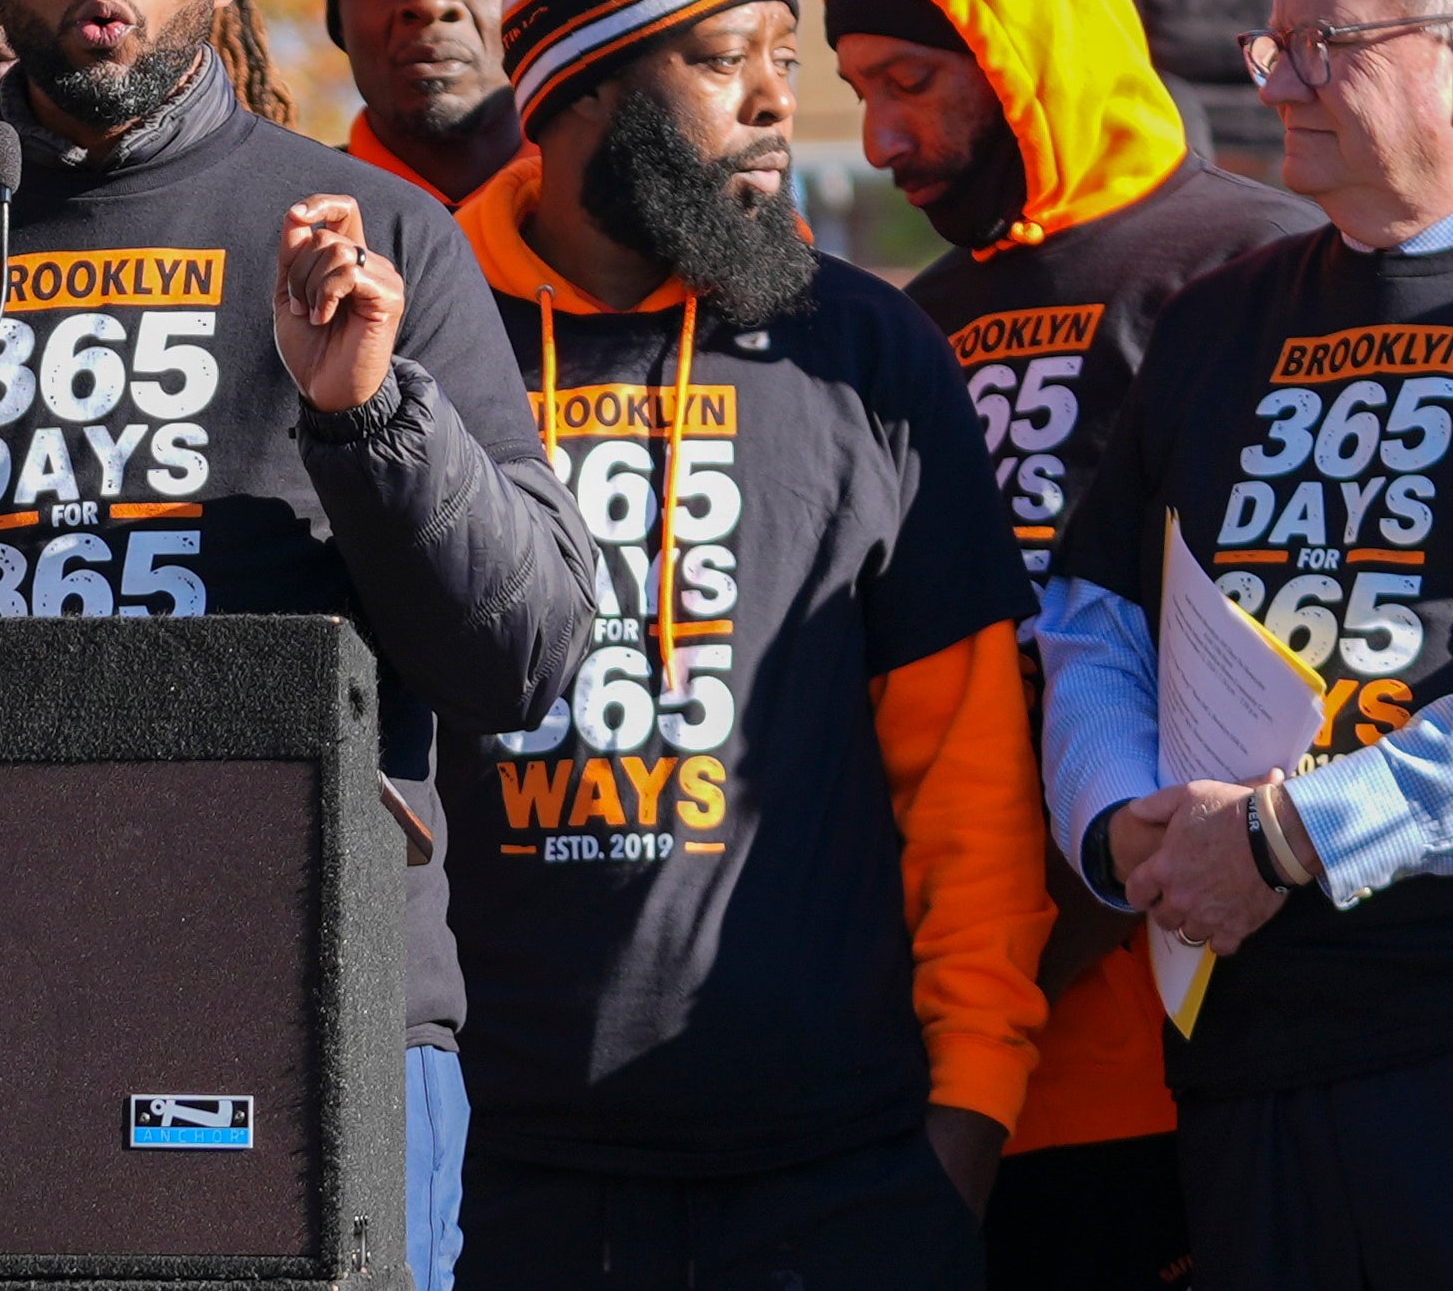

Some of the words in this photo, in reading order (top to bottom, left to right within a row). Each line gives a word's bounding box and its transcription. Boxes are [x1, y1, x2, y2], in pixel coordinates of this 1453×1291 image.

[955, 312, 1093, 359] OOKLYN
[967, 356, 1084, 453] 65
[51, 501, 98, 527] FOR
[555, 440, 741, 543] 65
[1217, 474, 1436, 546] DAYS
[1297, 548, 1340, 570] FOR
[595, 619, 639, 643] FOR
[1313, 678, 1414, 747] YS
[497, 756, 727, 830] WAYS
[544, 835, 605, 862] ESTD.
[610, 833, 674, 860] 2019
